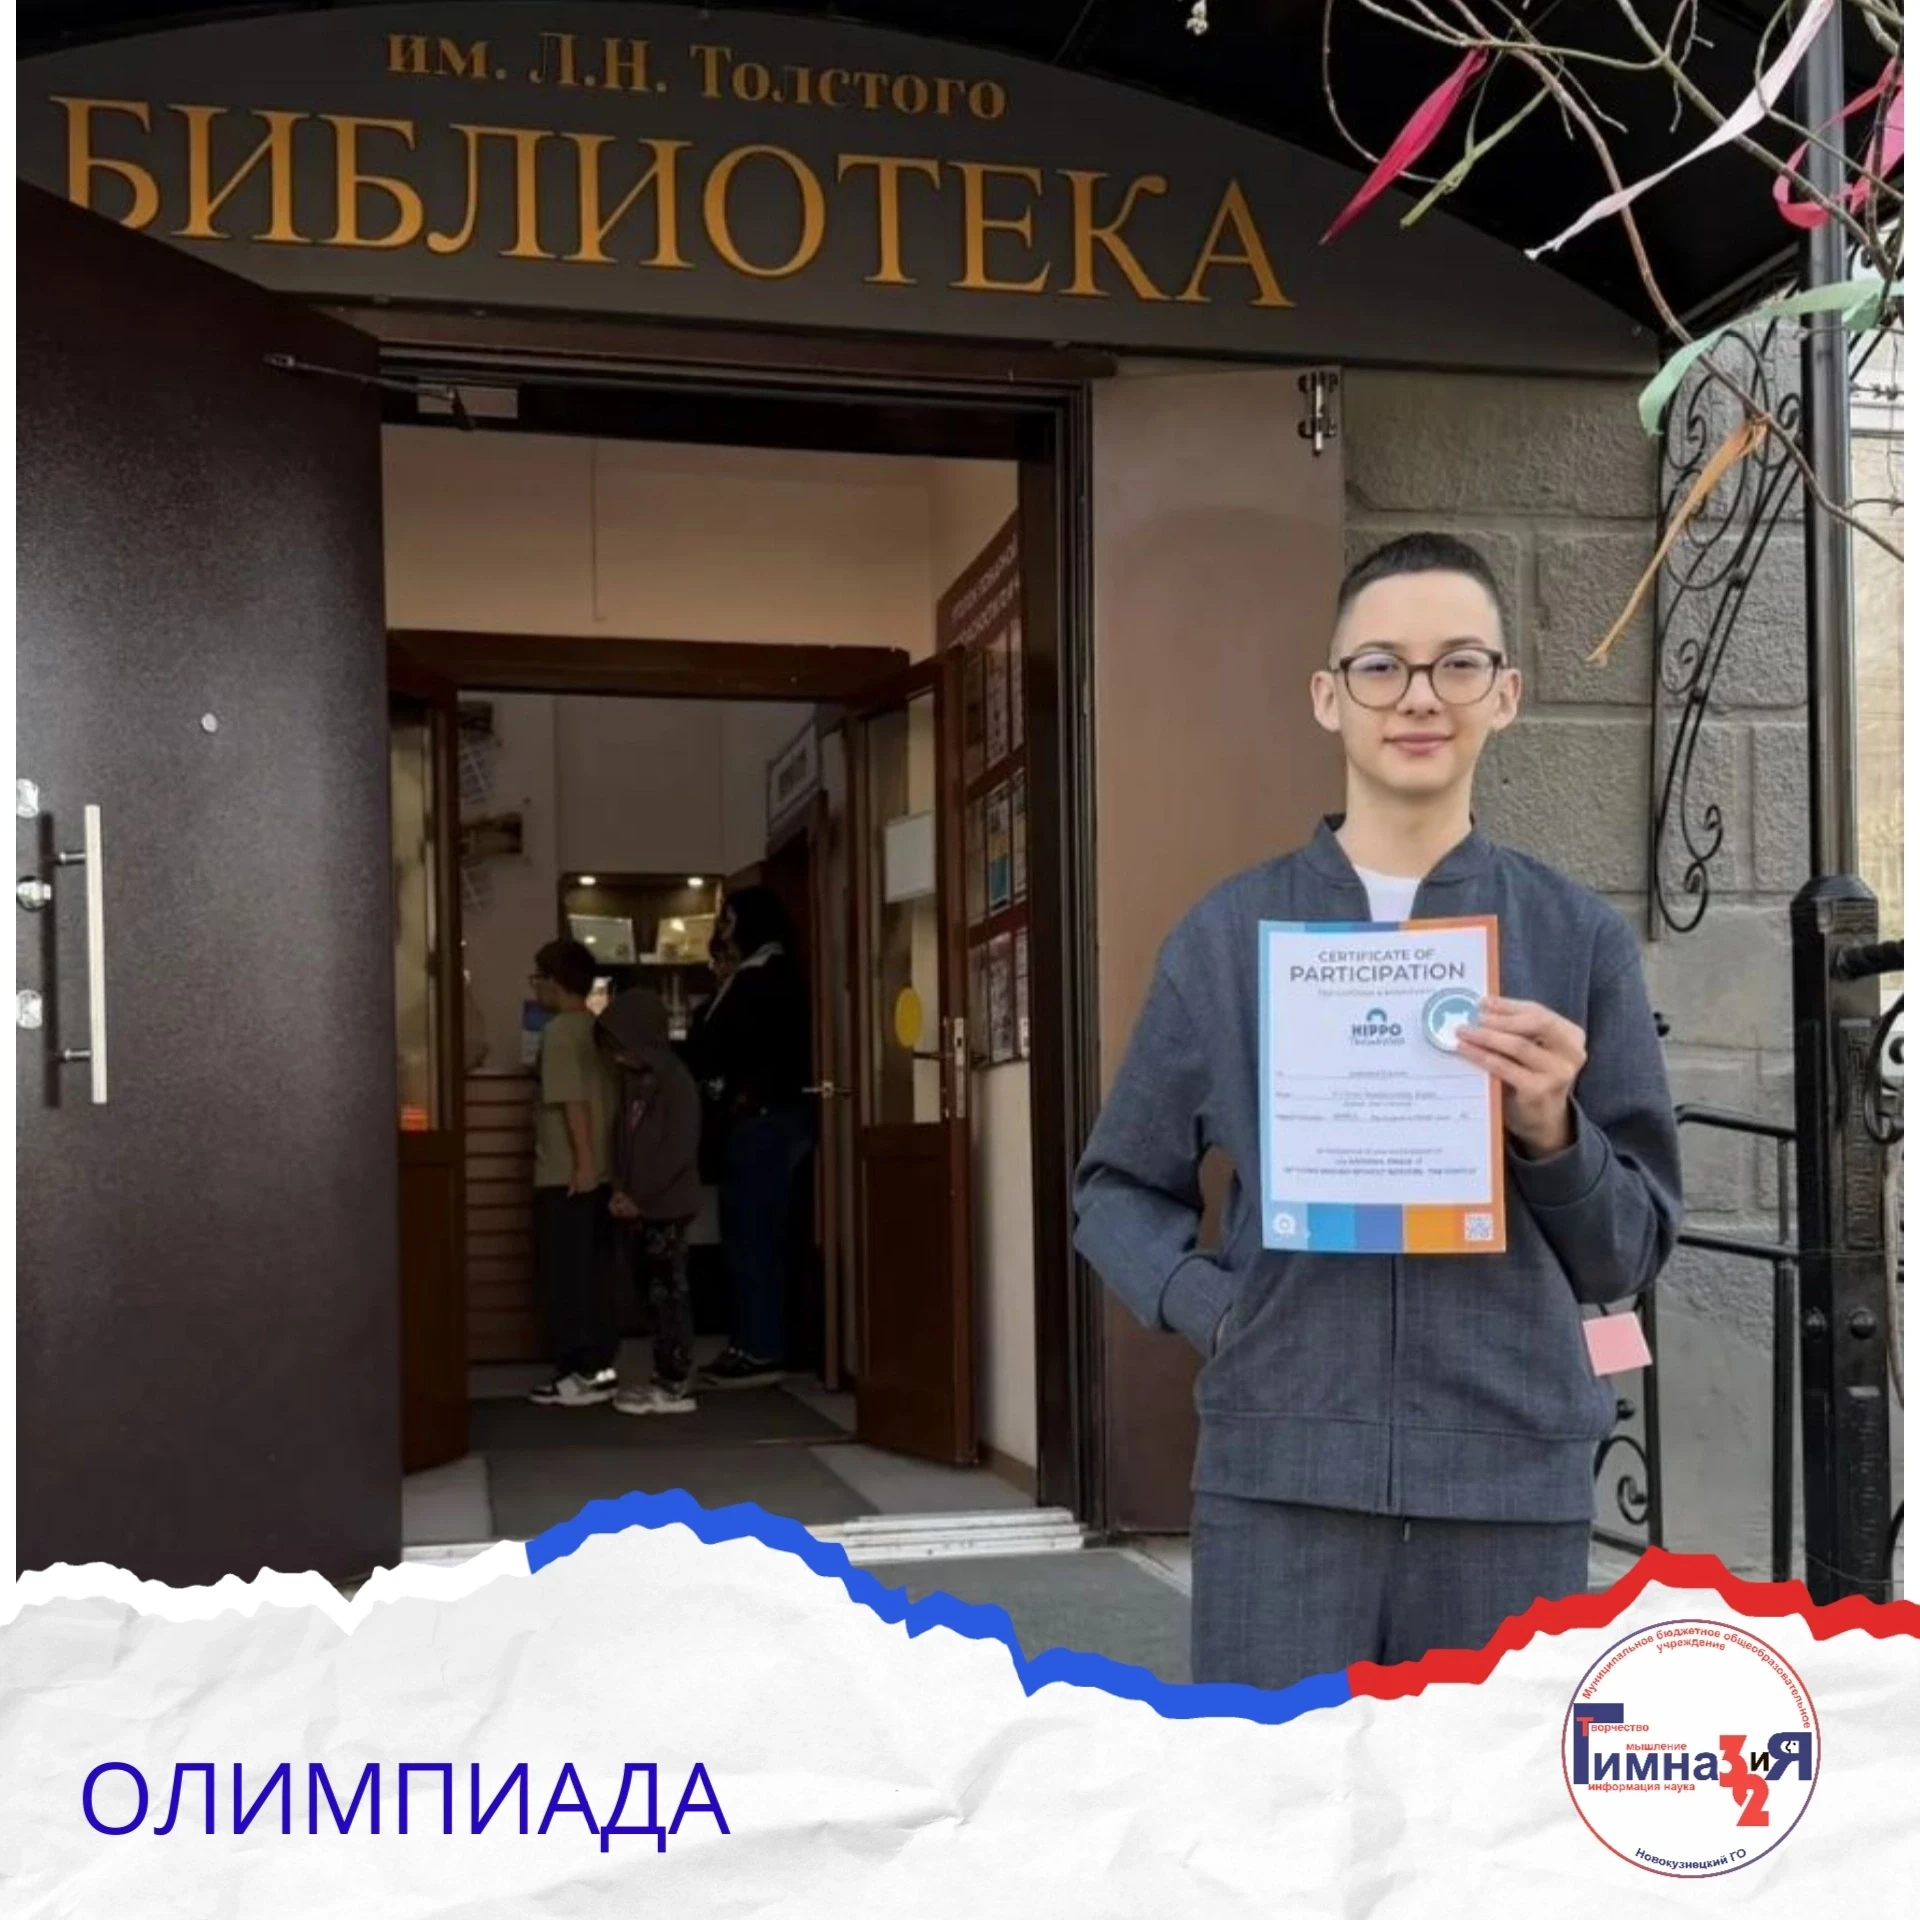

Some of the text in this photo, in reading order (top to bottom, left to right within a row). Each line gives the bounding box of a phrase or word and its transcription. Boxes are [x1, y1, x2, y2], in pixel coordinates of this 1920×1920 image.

[387, 31, 1007, 119] им. Л.Н. Толстого
[49, 95, 1297, 308] БИБЛИОТЕКА
[1318, 948, 1435, 963] CERTIFICATE OF
[1290, 962, 1466, 983] PARTICIPATION
[1351, 1022, 1402, 1038] HIPPO
